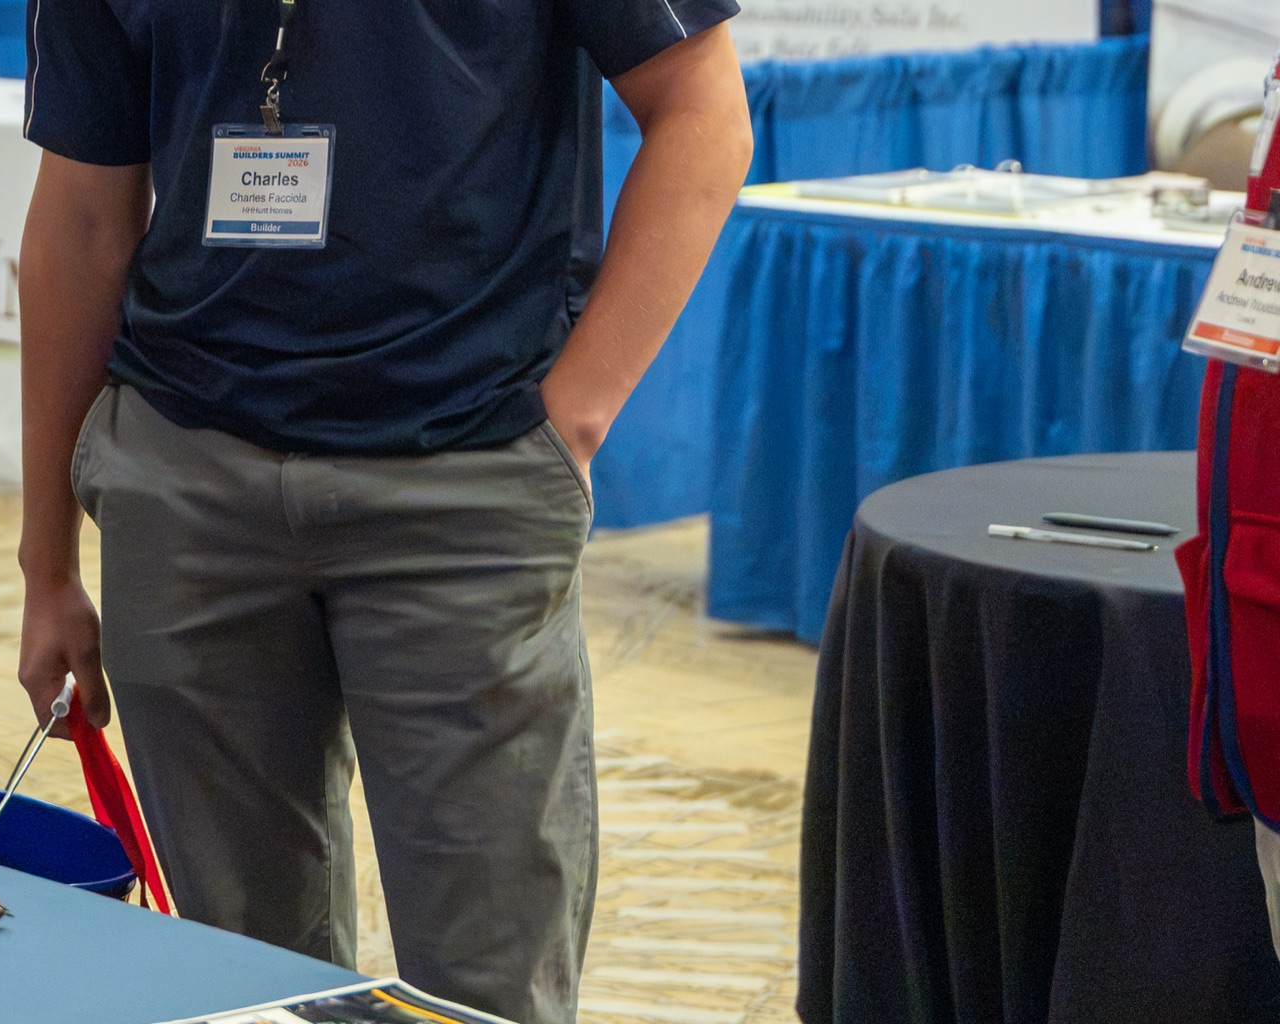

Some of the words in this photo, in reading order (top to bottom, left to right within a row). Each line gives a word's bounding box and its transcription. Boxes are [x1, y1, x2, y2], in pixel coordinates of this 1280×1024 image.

[287, 159, 309, 167] 2026
[241, 171, 299, 186] Charles
[230, 192, 267, 203] Charles
[268, 193, 307, 203] Facciola
[250, 223, 282, 233] Builder
